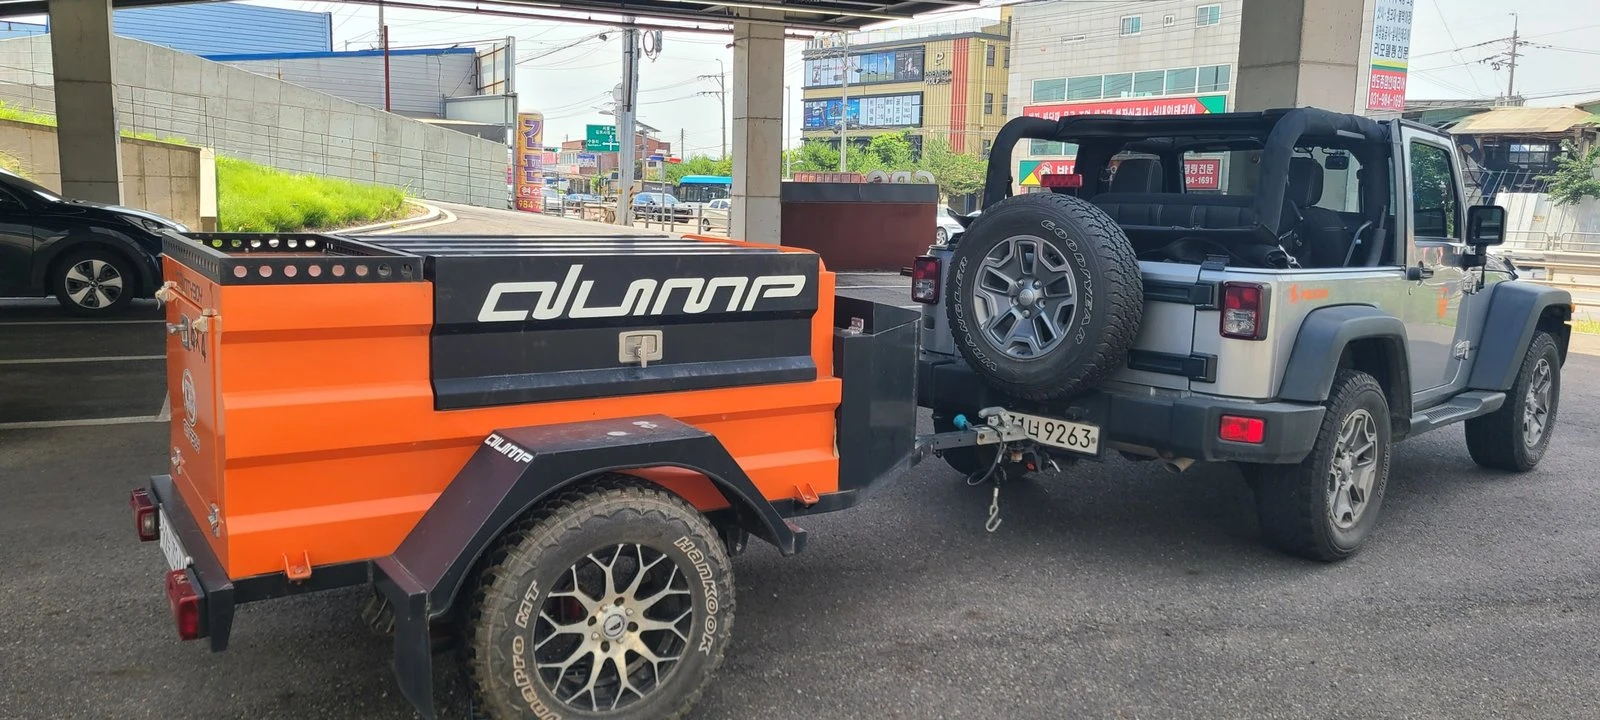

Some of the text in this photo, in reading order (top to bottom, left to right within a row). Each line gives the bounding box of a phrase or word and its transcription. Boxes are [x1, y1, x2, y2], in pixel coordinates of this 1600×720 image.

[1373, 42, 1409, 60] 리모델링 전문
[924, 77, 940, 85] GOLF
[1199, 164, 1214, 175] 전문
[521, 186, 542, 196] 현수
[1041, 219, 1094, 345] GOODYEAR
[954, 255, 998, 372] WRANGLER
[1044, 421, 1091, 448] 9263
[515, 579, 541, 629] MT
